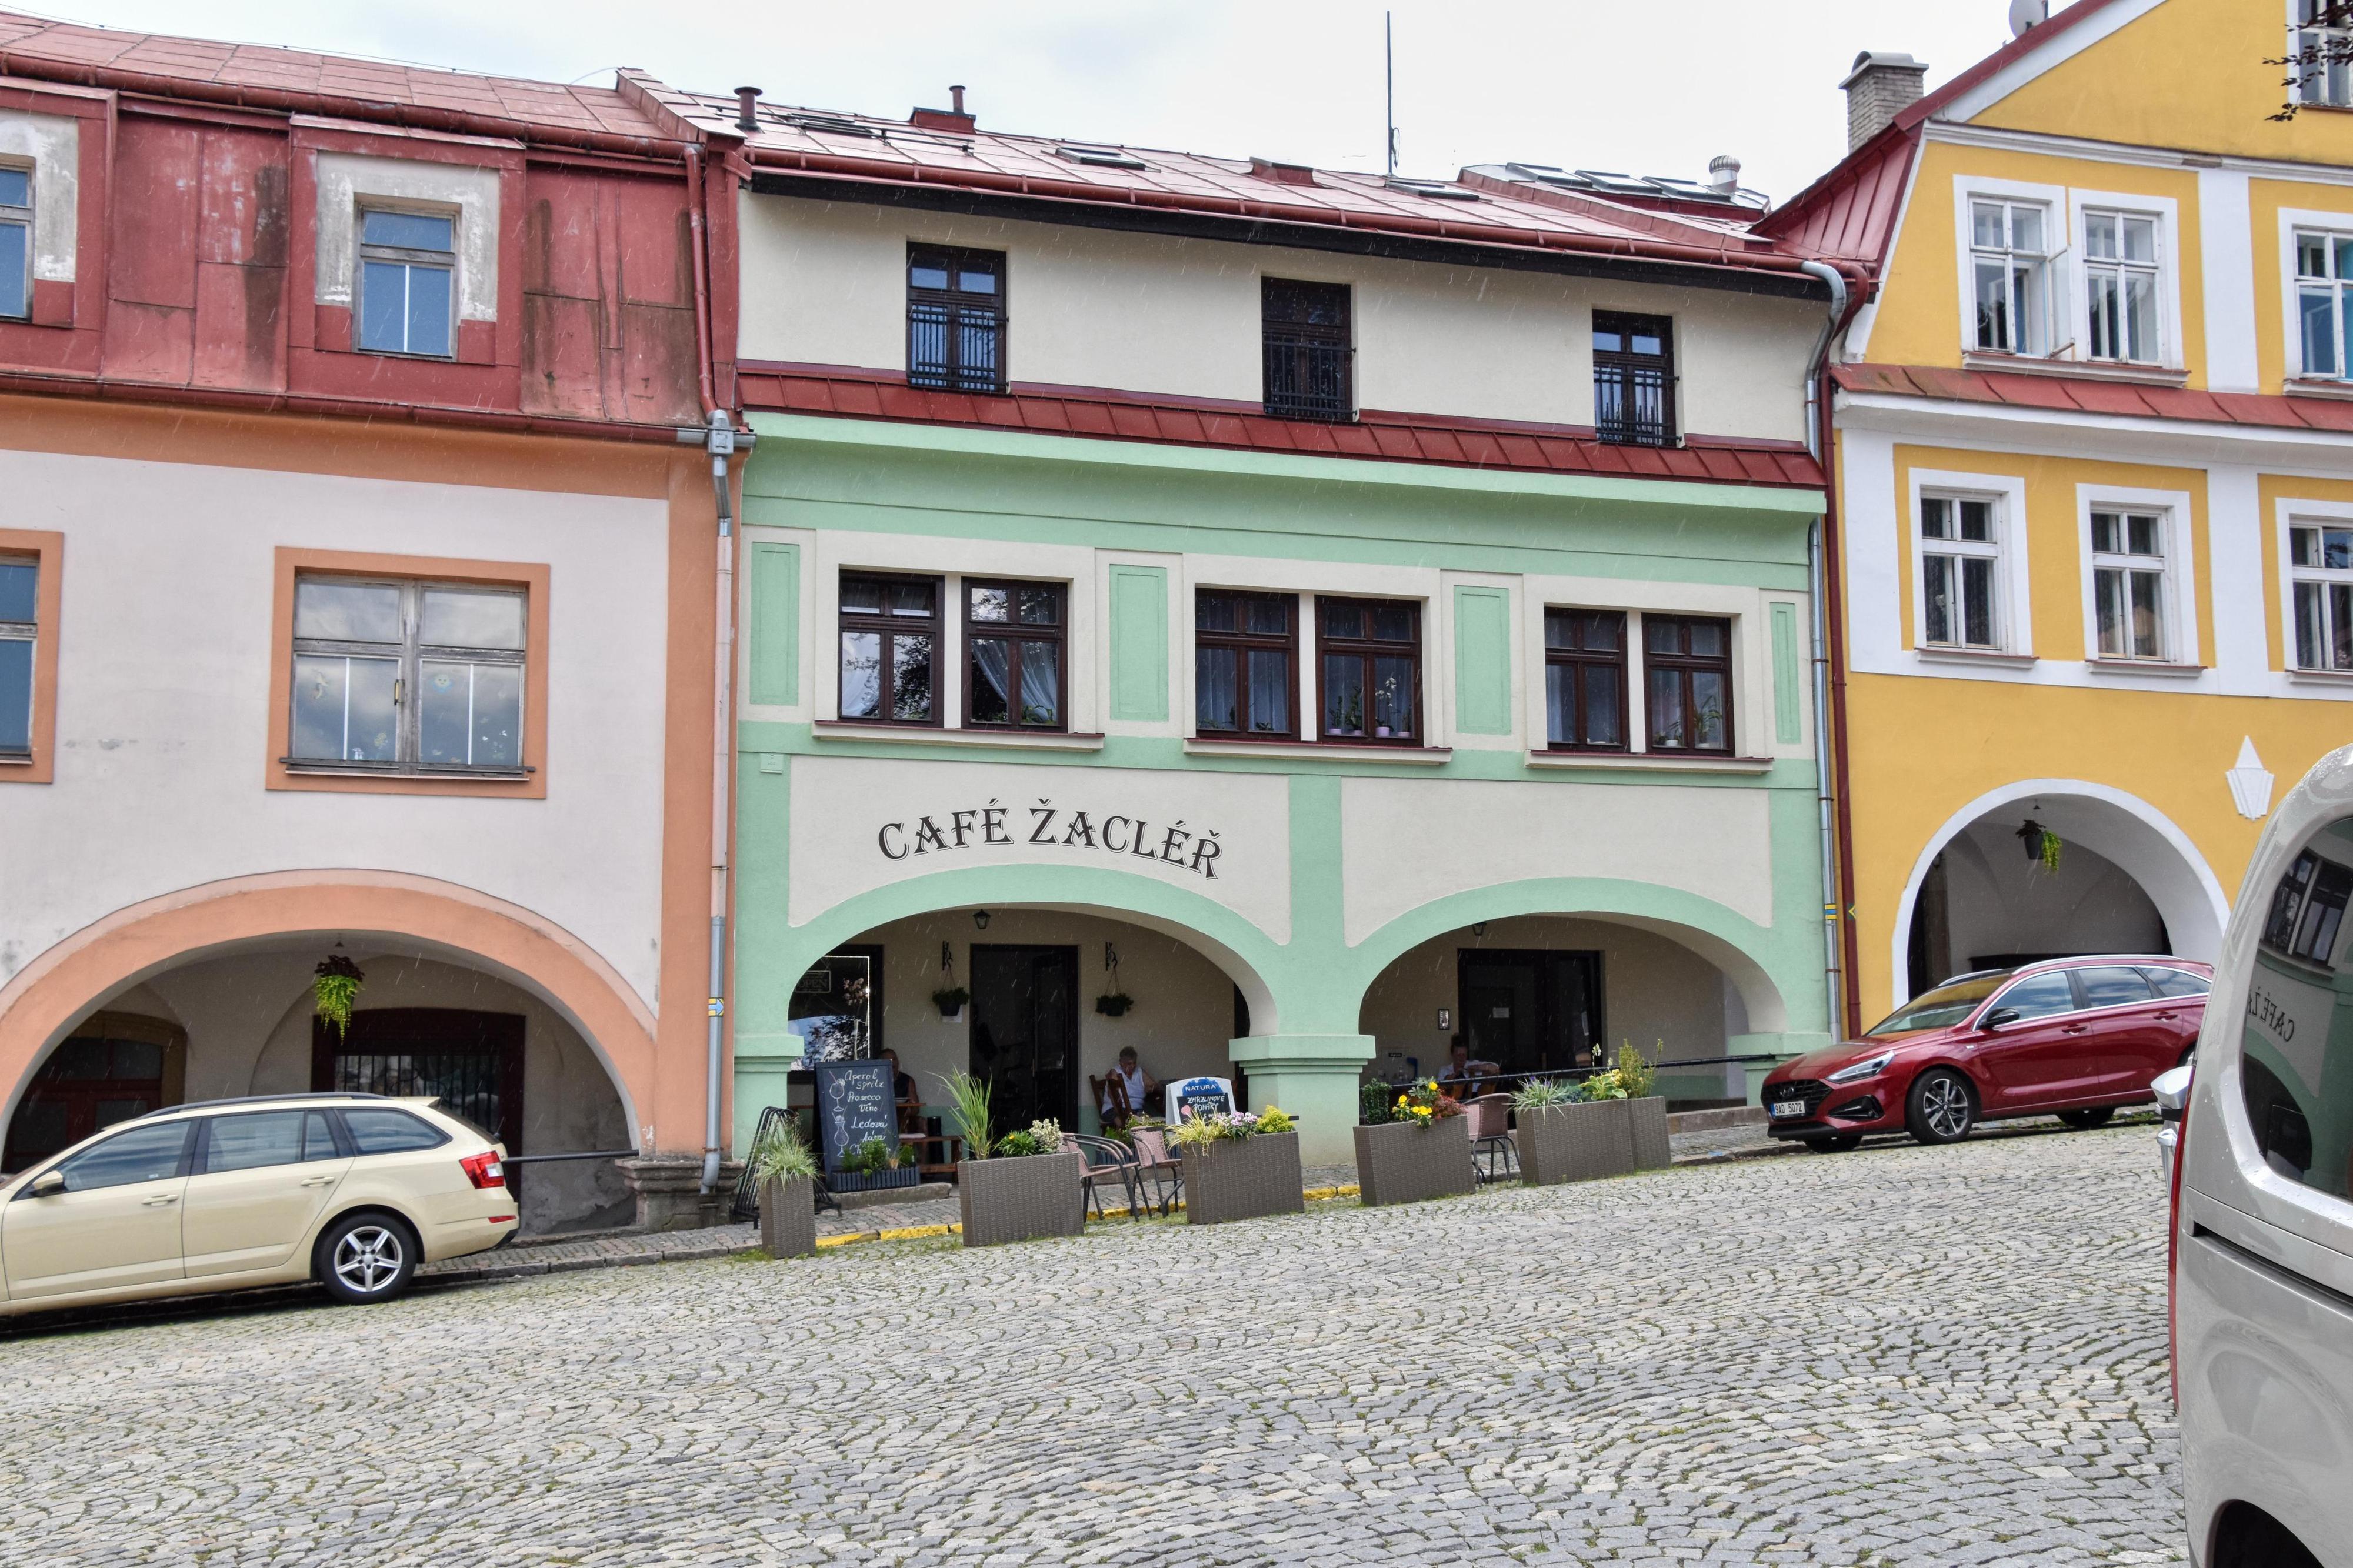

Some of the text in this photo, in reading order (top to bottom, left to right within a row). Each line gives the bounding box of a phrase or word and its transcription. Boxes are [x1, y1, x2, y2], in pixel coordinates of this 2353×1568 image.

[878, 798, 1223, 880] CAFÉ ŽACLÉŘ
[845, 1069, 878, 1086] Aperol
[848, 1091, 881, 1103] Prosecco
[1788, 1102, 1802, 1113] 5072
[851, 1114, 888, 1129] Ledová
